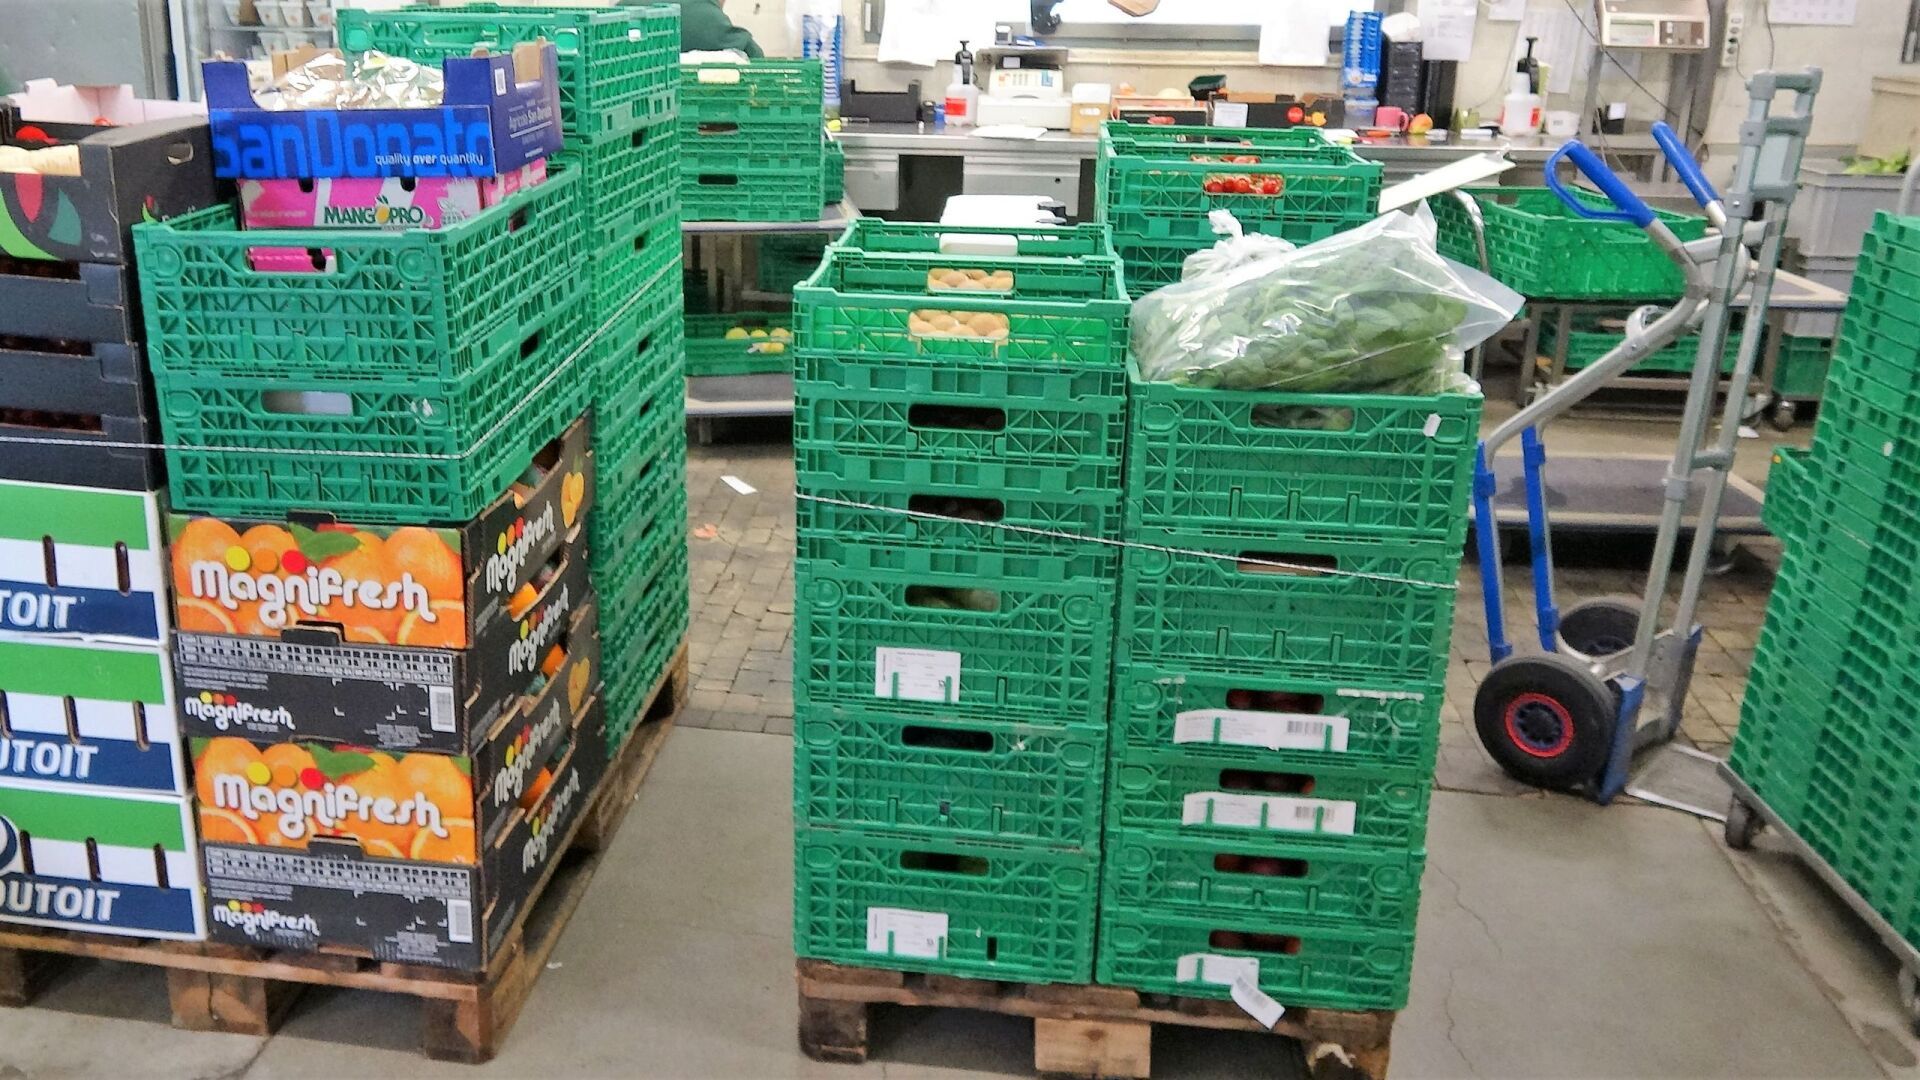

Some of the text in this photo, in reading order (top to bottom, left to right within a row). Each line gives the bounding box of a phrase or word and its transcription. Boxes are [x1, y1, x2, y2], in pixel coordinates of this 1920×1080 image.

[375, 153, 484, 166] quality over quantity
[0, 879, 120, 921] UTOIT
